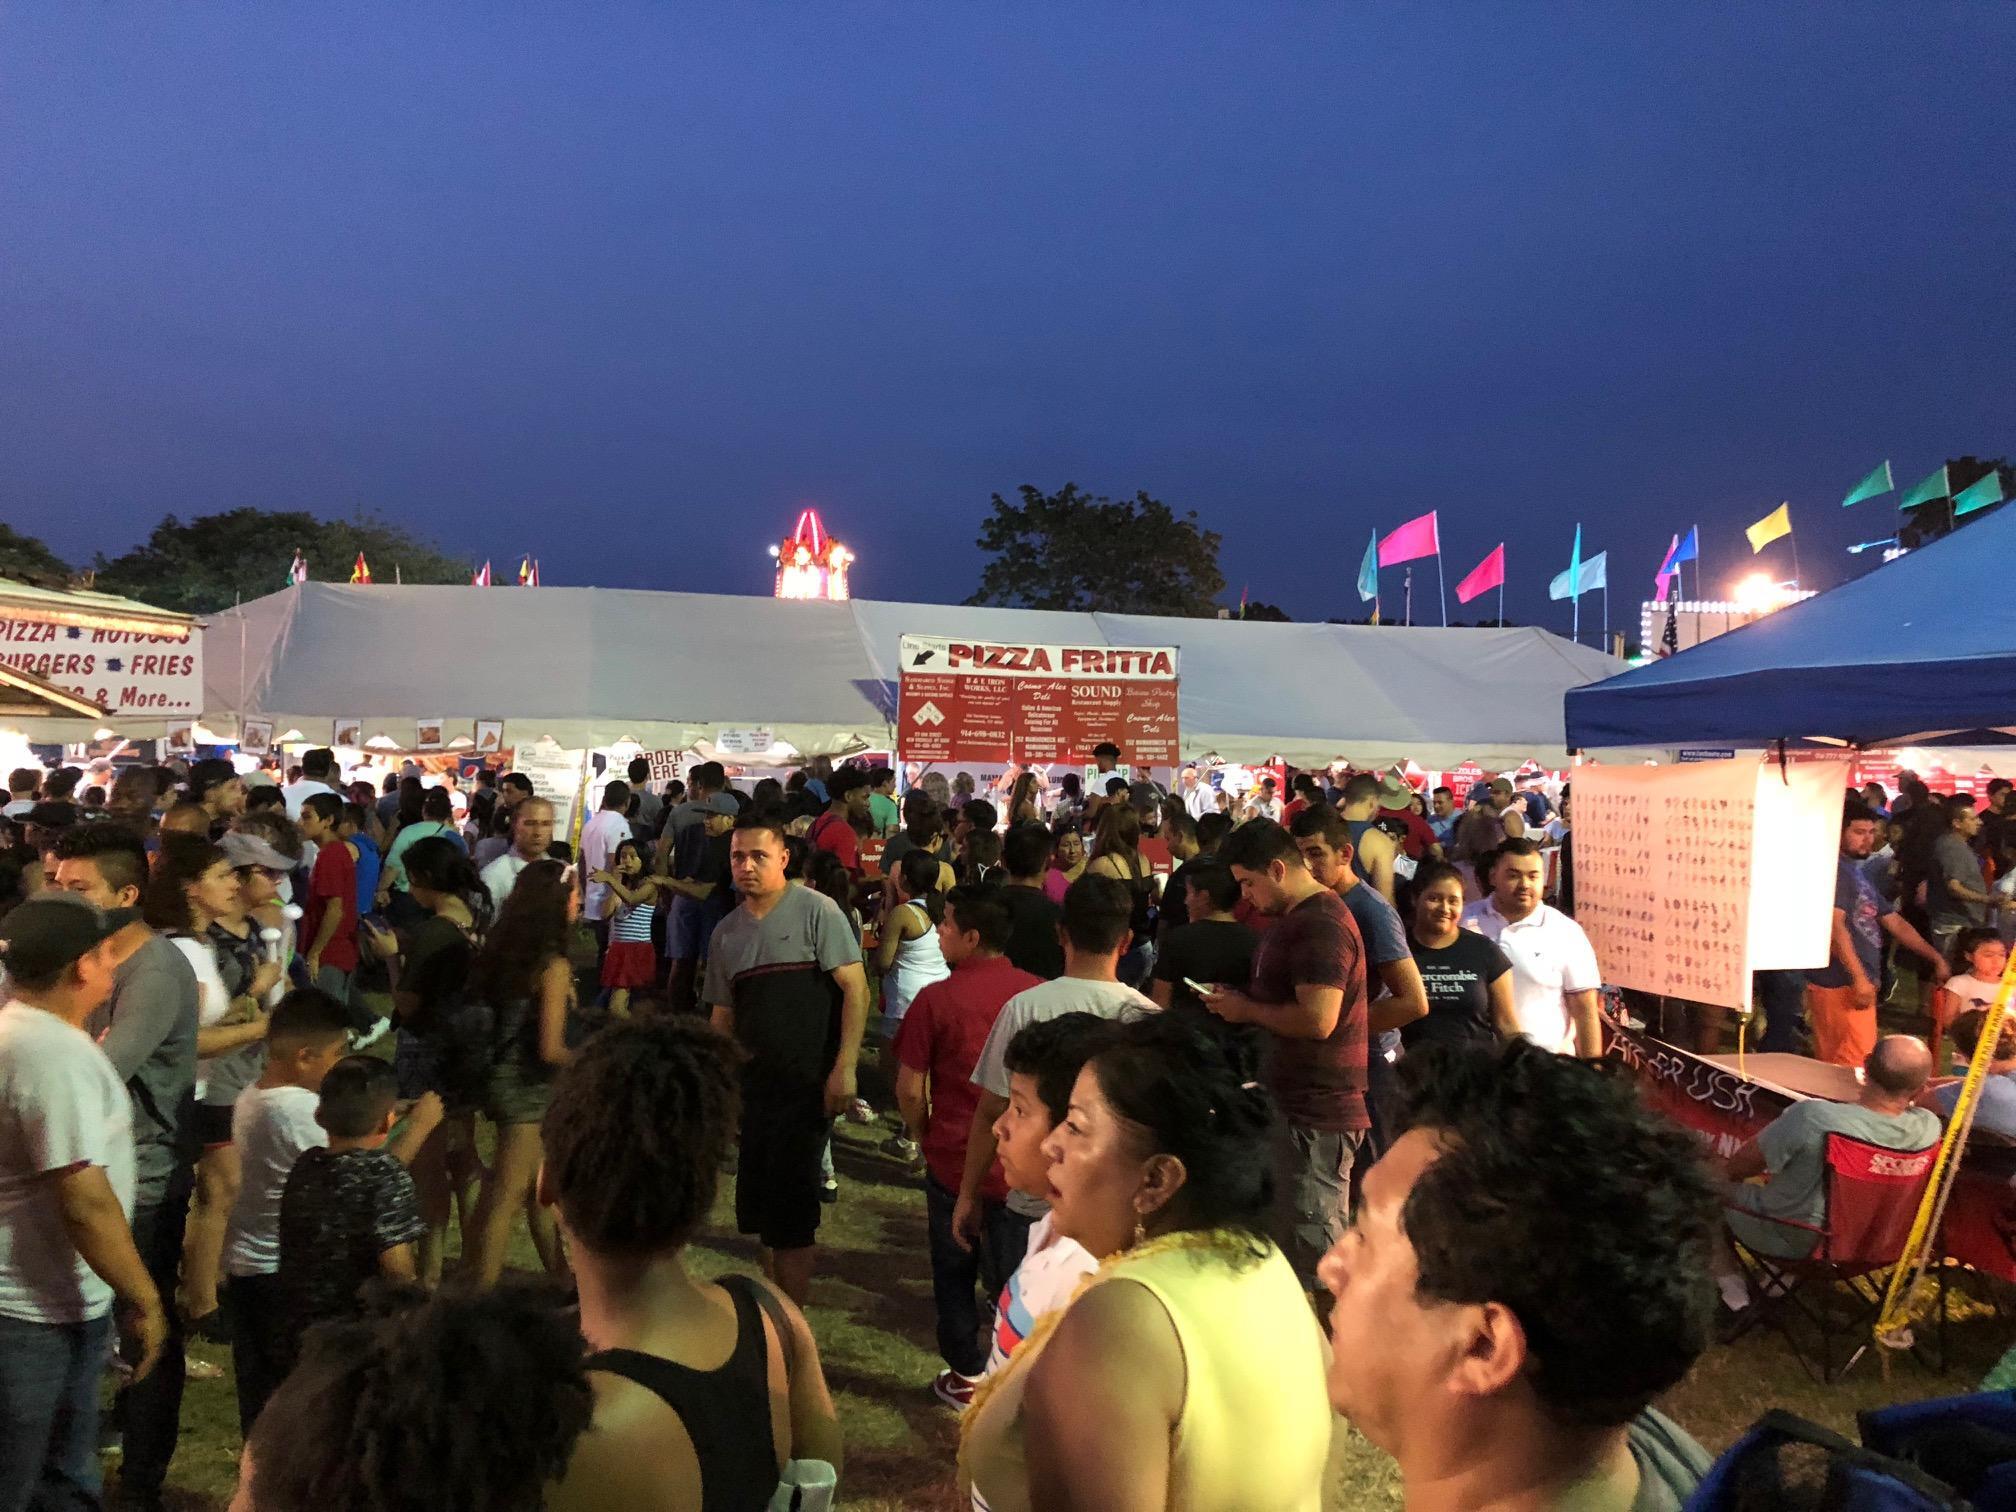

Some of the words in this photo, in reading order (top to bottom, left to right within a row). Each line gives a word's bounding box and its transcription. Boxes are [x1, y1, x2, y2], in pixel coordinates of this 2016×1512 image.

[0, 621, 56, 642] PIZZA
[130, 655, 194, 676] FRIES
[948, 644, 1052, 671] PIZZA
[1062, 649, 1173, 675] FRITTA
[1071, 685, 1122, 698] SOUND
[649, 764, 680, 781] ERE
[1431, 982, 1465, 993] Fitch
